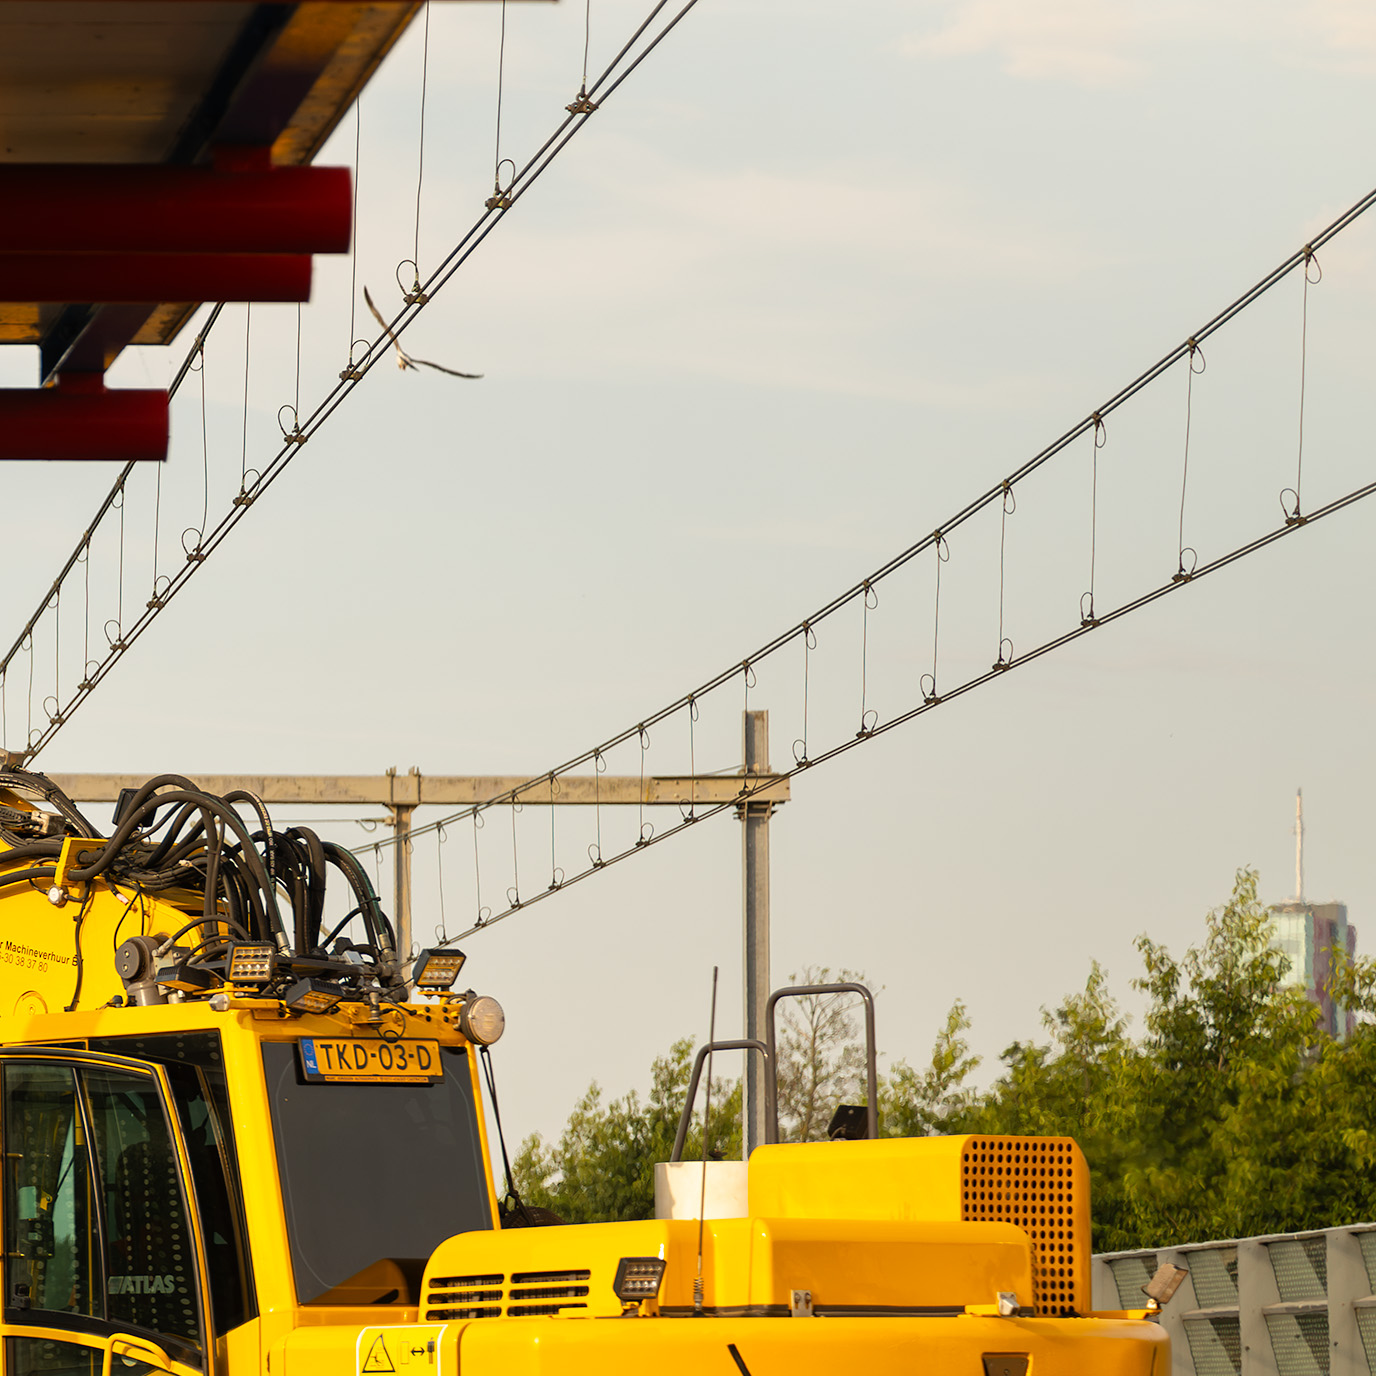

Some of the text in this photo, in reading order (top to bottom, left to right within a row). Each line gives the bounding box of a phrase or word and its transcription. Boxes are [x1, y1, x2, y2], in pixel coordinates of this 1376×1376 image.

[5, 940, 70, 965] Machineverhuur
[306, 1060, 317, 1069] NL
[320, 1043, 432, 1071] TKD-03-D
[120, 1274, 176, 1295] ATLAS
